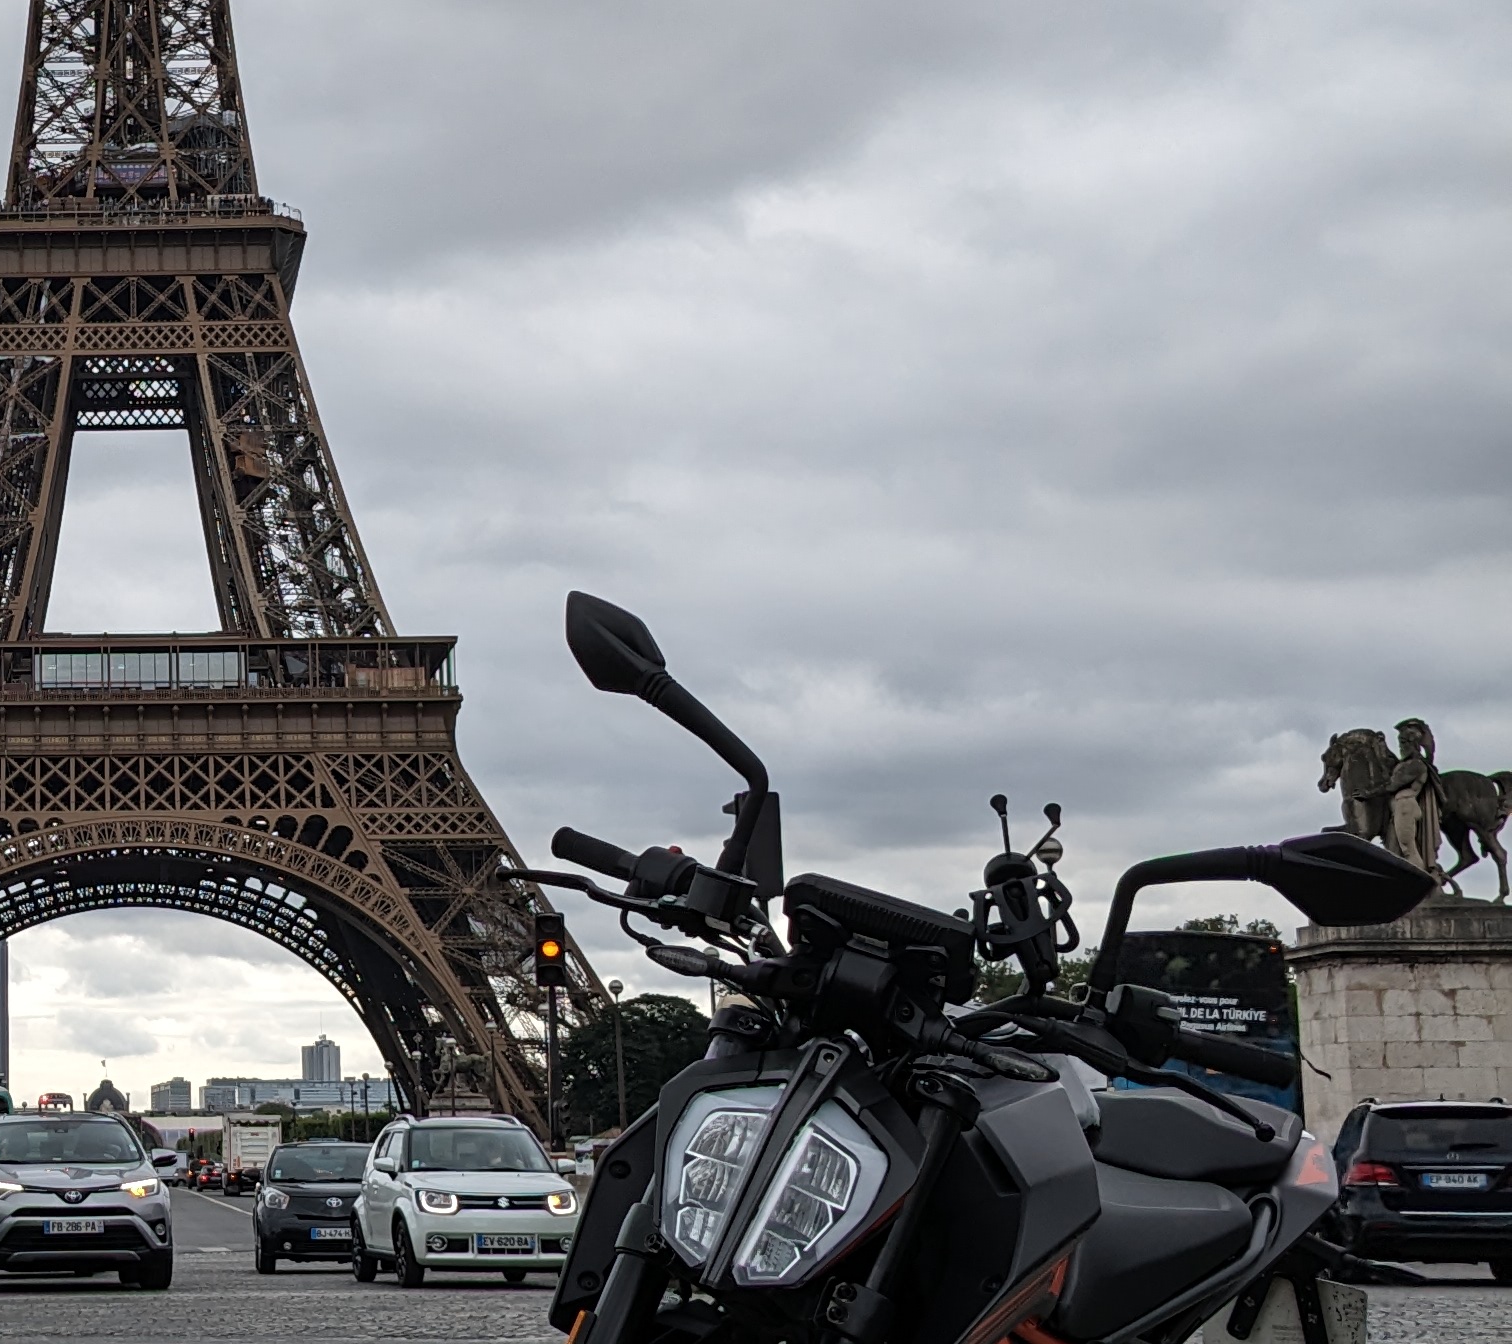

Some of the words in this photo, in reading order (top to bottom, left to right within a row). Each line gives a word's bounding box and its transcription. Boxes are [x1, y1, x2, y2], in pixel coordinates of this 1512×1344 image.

[1190, 1007, 1204, 1019] DE
[1205, 1008, 1220, 1019] LA
[1221, 1007, 1267, 1022] TÜRKİYE
